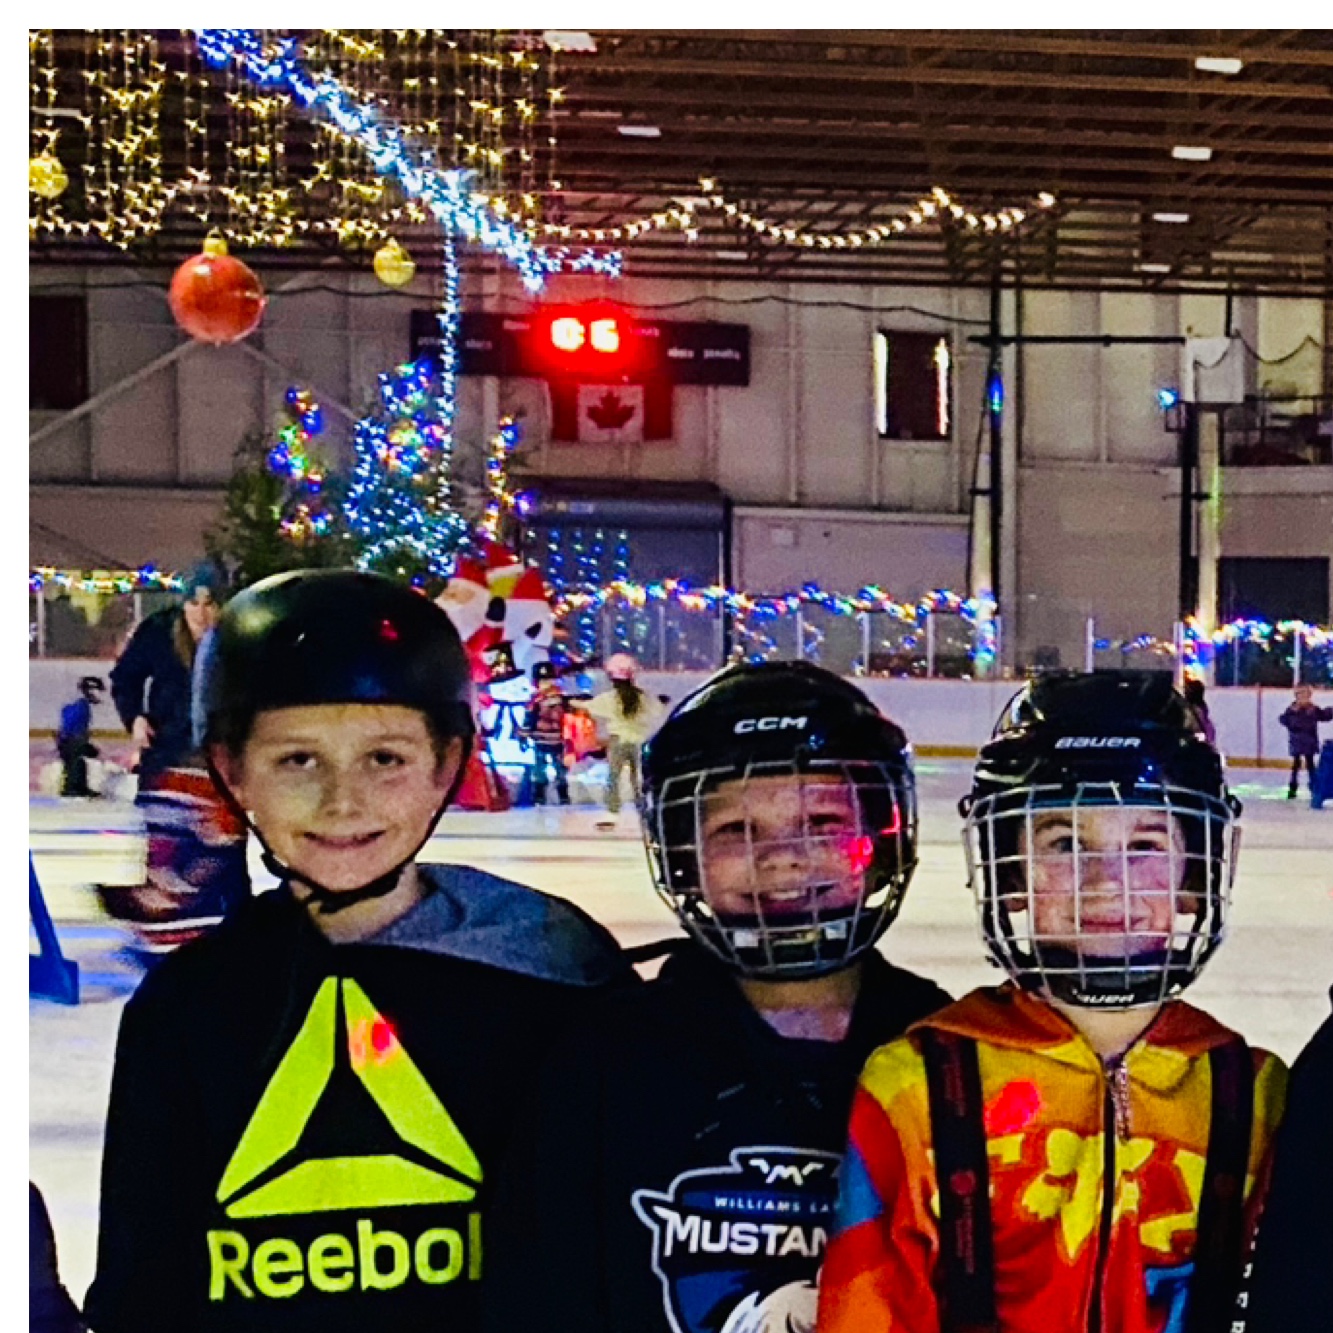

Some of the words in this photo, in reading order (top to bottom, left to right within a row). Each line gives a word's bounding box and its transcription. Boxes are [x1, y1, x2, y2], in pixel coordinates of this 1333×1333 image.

[734, 715, 808, 735] CCM
[714, 1196, 800, 1213] WILLIAMS
[652, 1205, 829, 1258] MUSTAN
